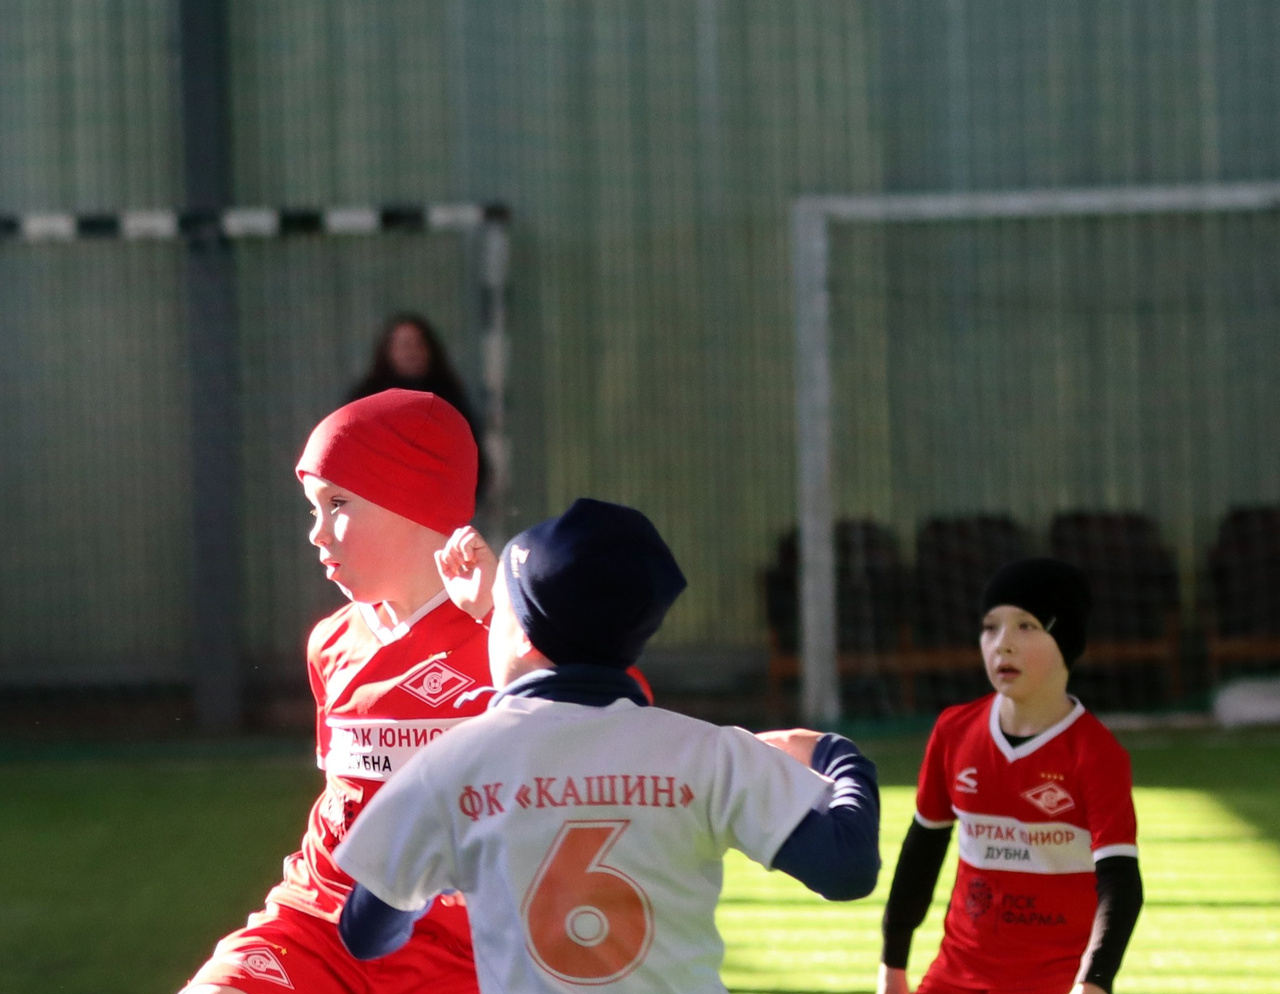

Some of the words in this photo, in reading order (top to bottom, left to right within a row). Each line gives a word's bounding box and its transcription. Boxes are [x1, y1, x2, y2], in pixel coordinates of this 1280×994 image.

[378, 727, 449, 748] ЮНИО
[458, 782, 505, 822] ФК
[514, 774, 695, 809] «КАШИН»
[985, 846, 1031, 861] ДУБНА
[521, 819, 655, 986] 6
[1002, 910, 1067, 926] ФАРМА
